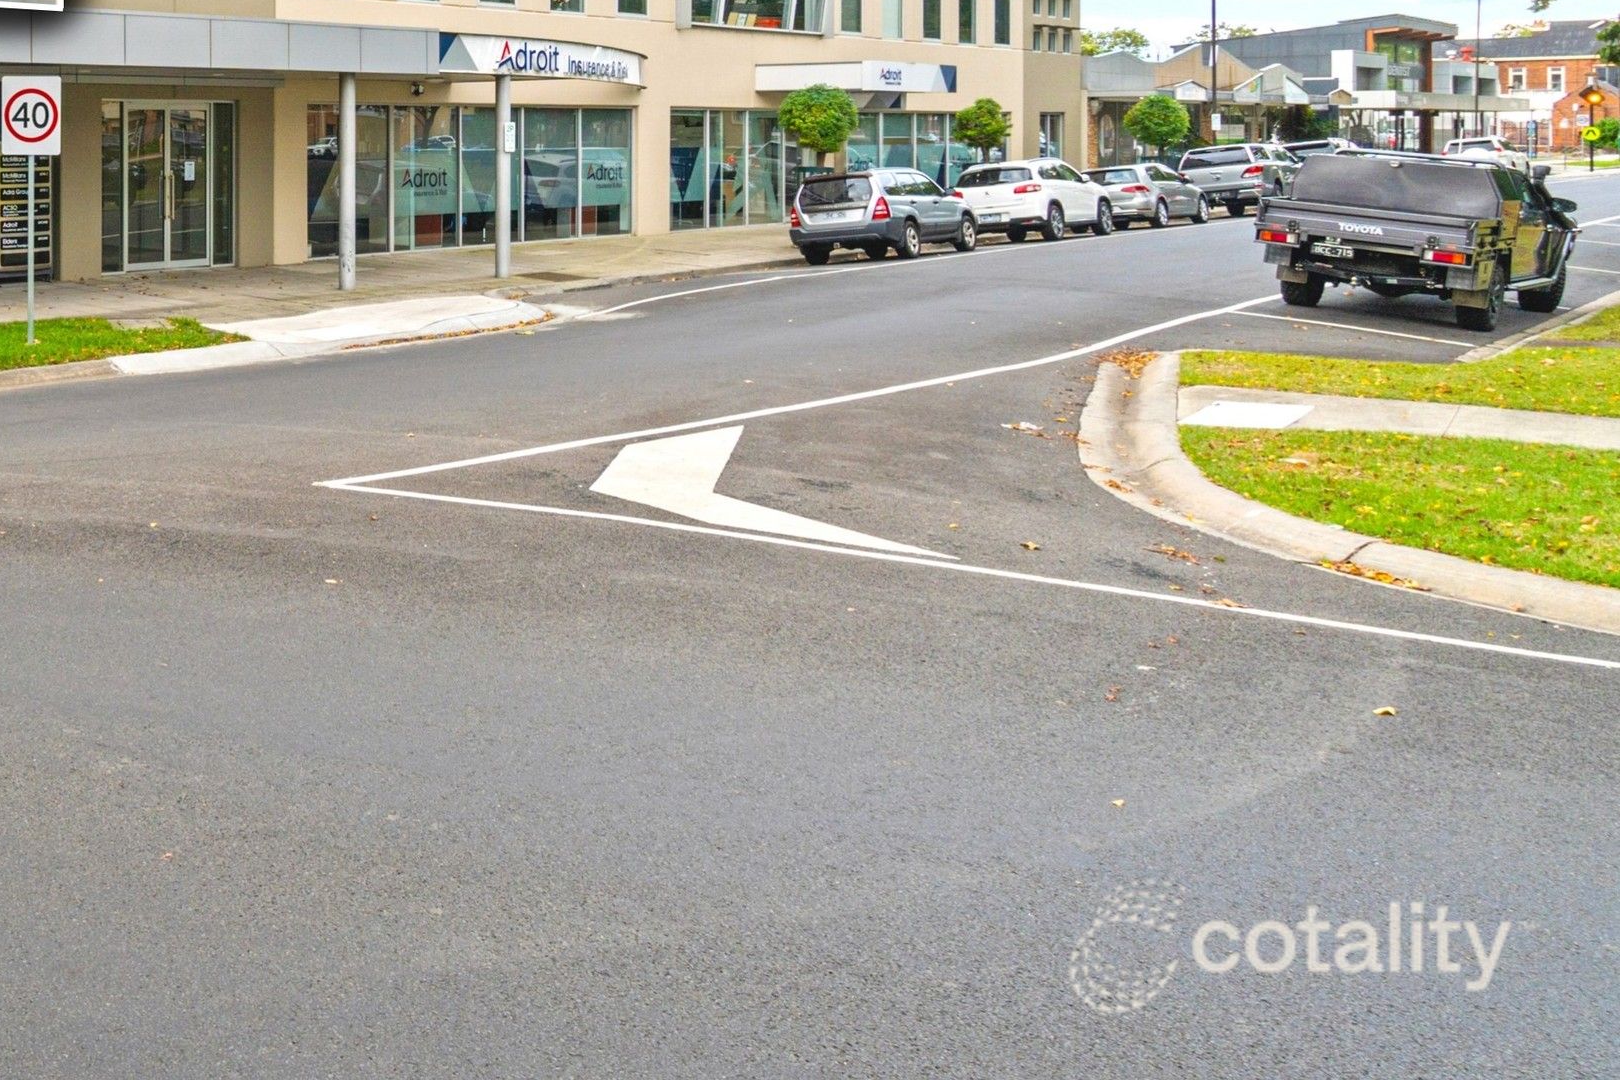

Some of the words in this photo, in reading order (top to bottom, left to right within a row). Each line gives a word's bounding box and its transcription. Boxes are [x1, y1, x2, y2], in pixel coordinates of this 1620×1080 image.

[498, 41, 560, 71] Adroit
[568, 55, 609, 77] Insurance
[880, 68, 902, 80] Adroit
[11, 101, 50, 129] 40
[402, 168, 447, 187] Adroit
[587, 163, 623, 180] Adroit
[1339, 222, 1383, 235] TOYOTA
